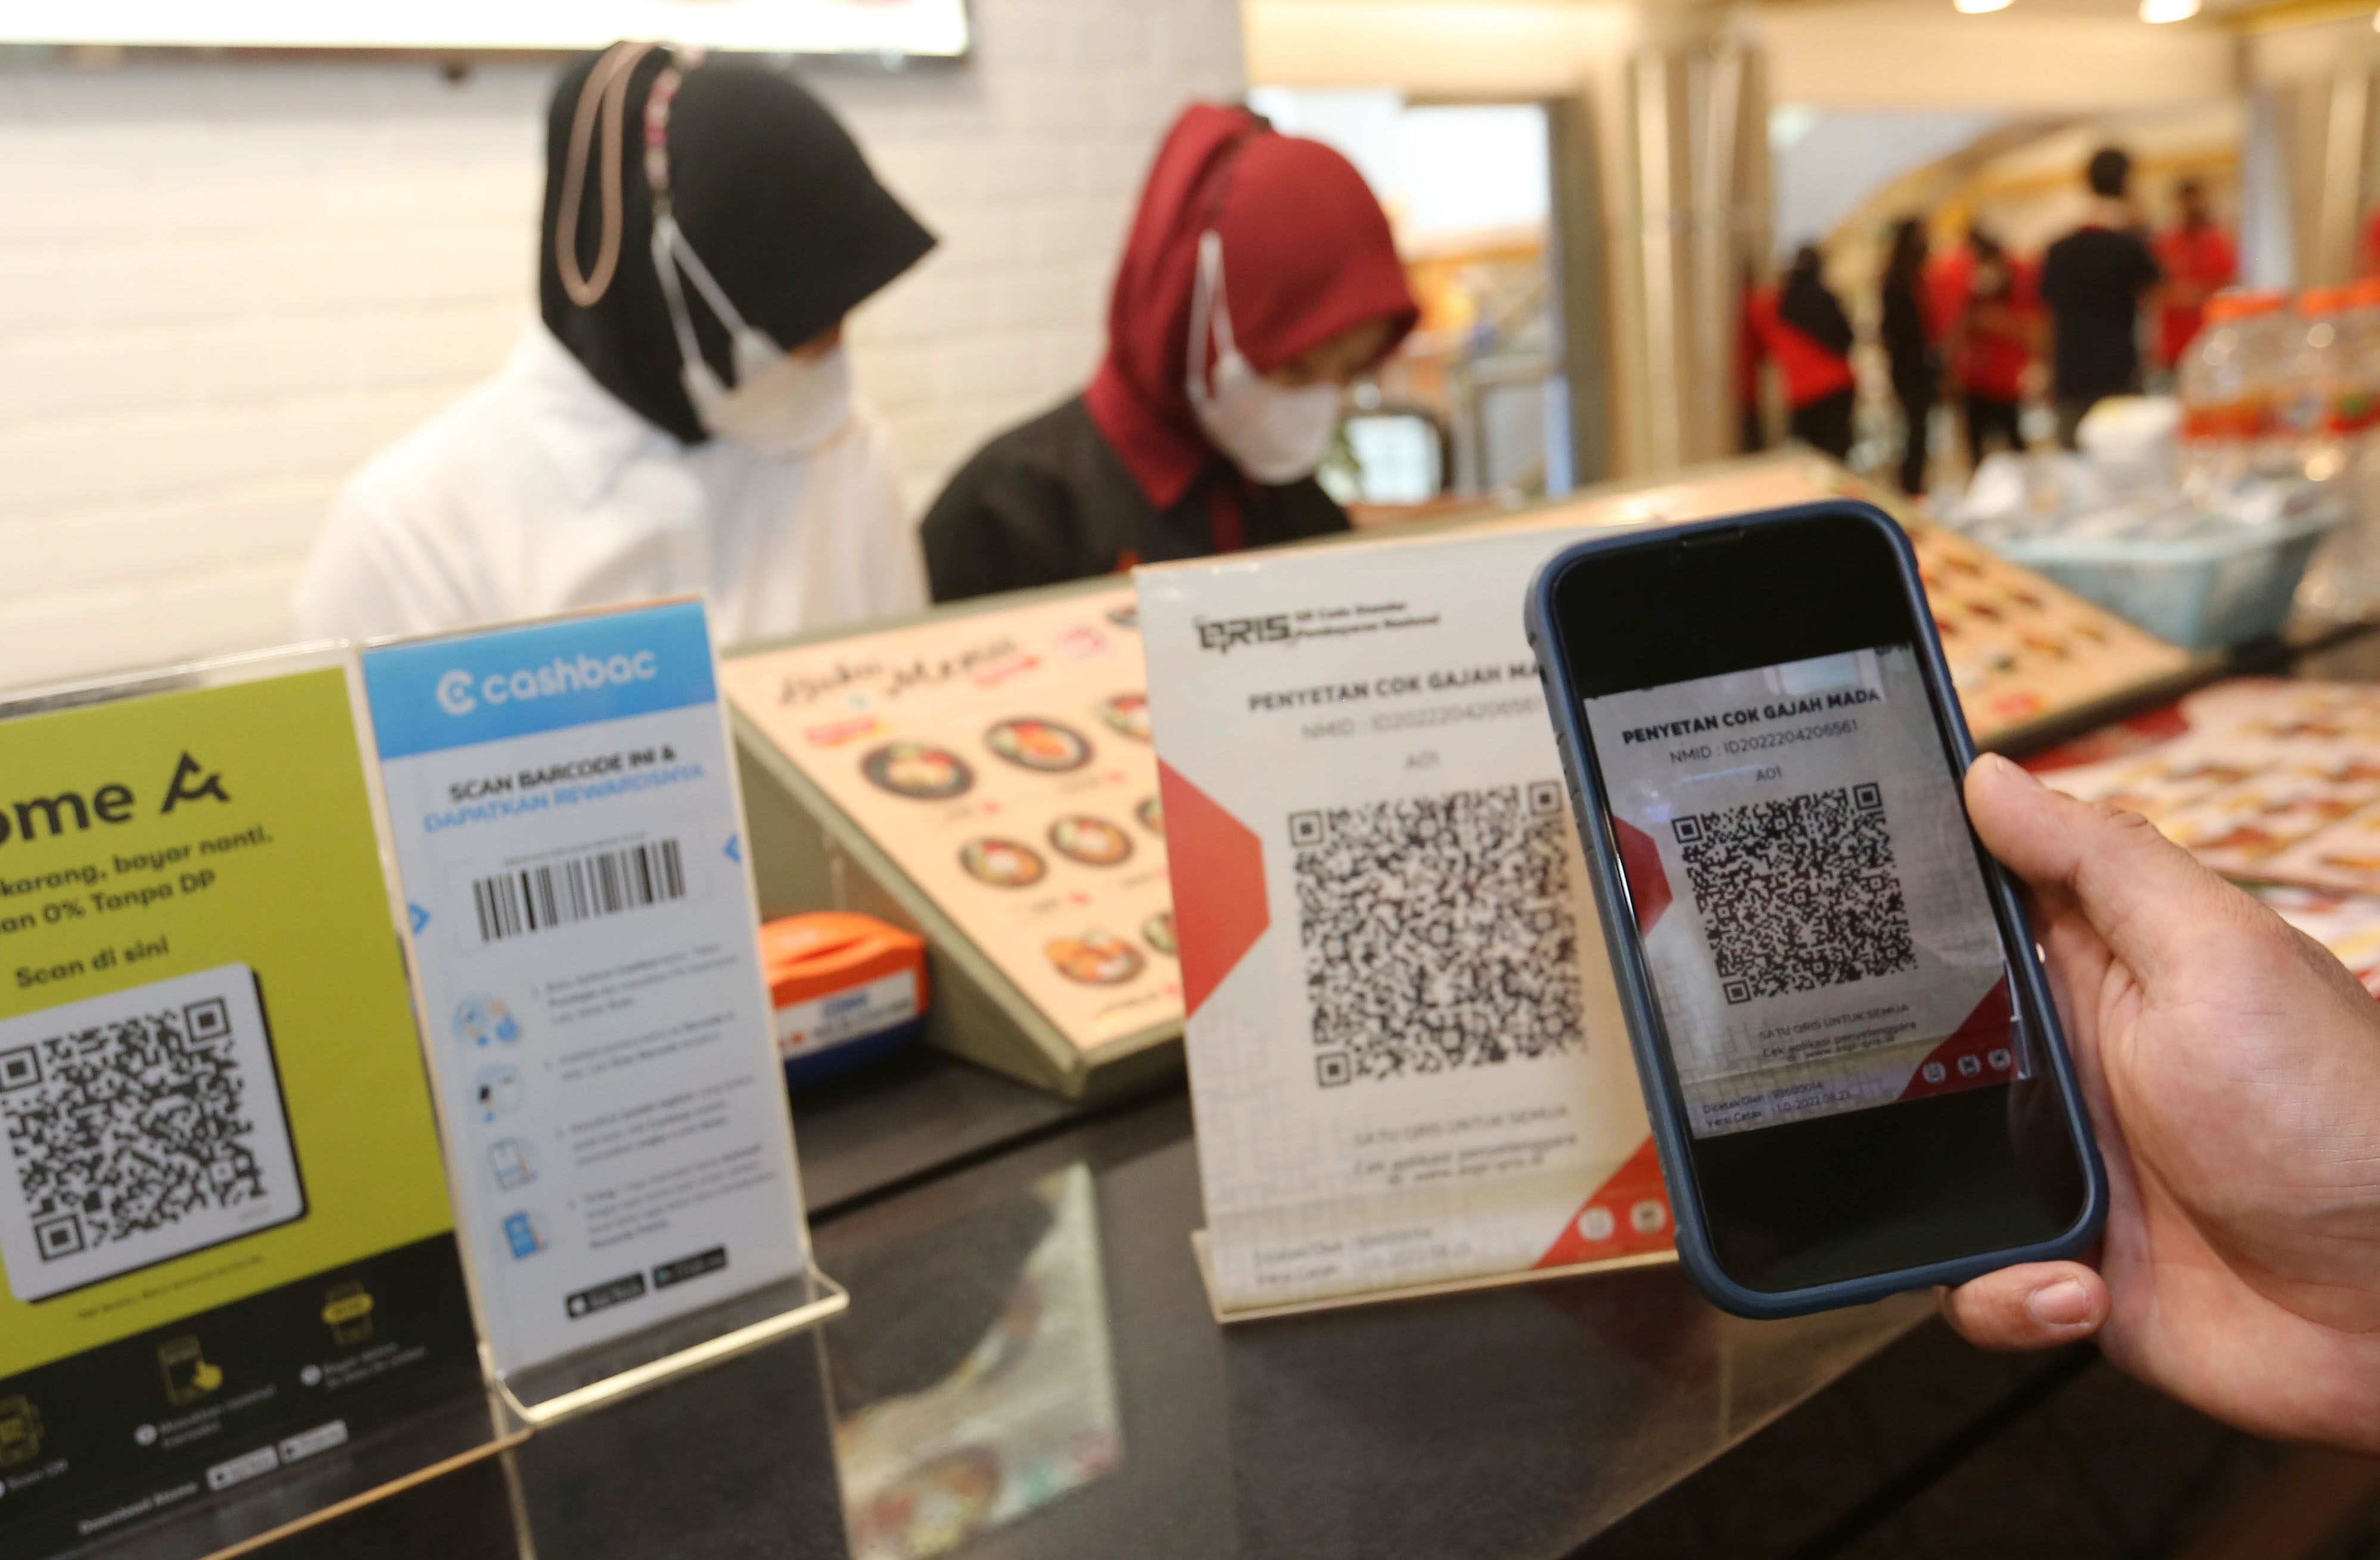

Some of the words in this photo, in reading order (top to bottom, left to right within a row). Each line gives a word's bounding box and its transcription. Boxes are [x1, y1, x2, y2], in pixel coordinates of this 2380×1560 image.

[1197, 613, 1291, 655] QRIS
[481, 650, 657, 705] cashbac
[1249, 680, 1370, 710] PENYETAN
[1374, 675, 1421, 696] COK
[1428, 666, 1502, 689] GAJAH
[1622, 715, 1718, 744] PENYETAN
[1723, 707, 1761, 728] COK
[1764, 698, 1823, 720] GAJAH
[1828, 689, 1880, 708] MADA
[449, 776, 513, 803] SCAN
[517, 752, 623, 790] BARCODE
[628, 747, 655, 768] INI
[661, 744, 676, 762] &
[1669, 746, 1712, 764] NMID
[1756, 766, 1782, 782] A01
[423, 794, 550, 834] DAPATKAN
[112, 843, 192, 875] bayar
[199, 825, 273, 856] nanti.
[42, 899, 86, 925] 0%
[91, 882, 174, 912] Tanpa
[179, 868, 216, 894] DP
[15, 959, 86, 989] Scan
[91, 947, 117, 972] di
[123, 934, 170, 964] sini
[1758, 1026, 1790, 1040] SATU
[1793, 1021, 1822, 1033] QRIS
[1824, 1013, 1864, 1027] UNTUK
[1866, 1004, 1909, 1020] SEMUA
[1763, 1047, 1785, 1058] Cek
[1788, 1037, 1831, 1054] aplikasi
[1833, 1020, 1917, 1044] penyelenggara
